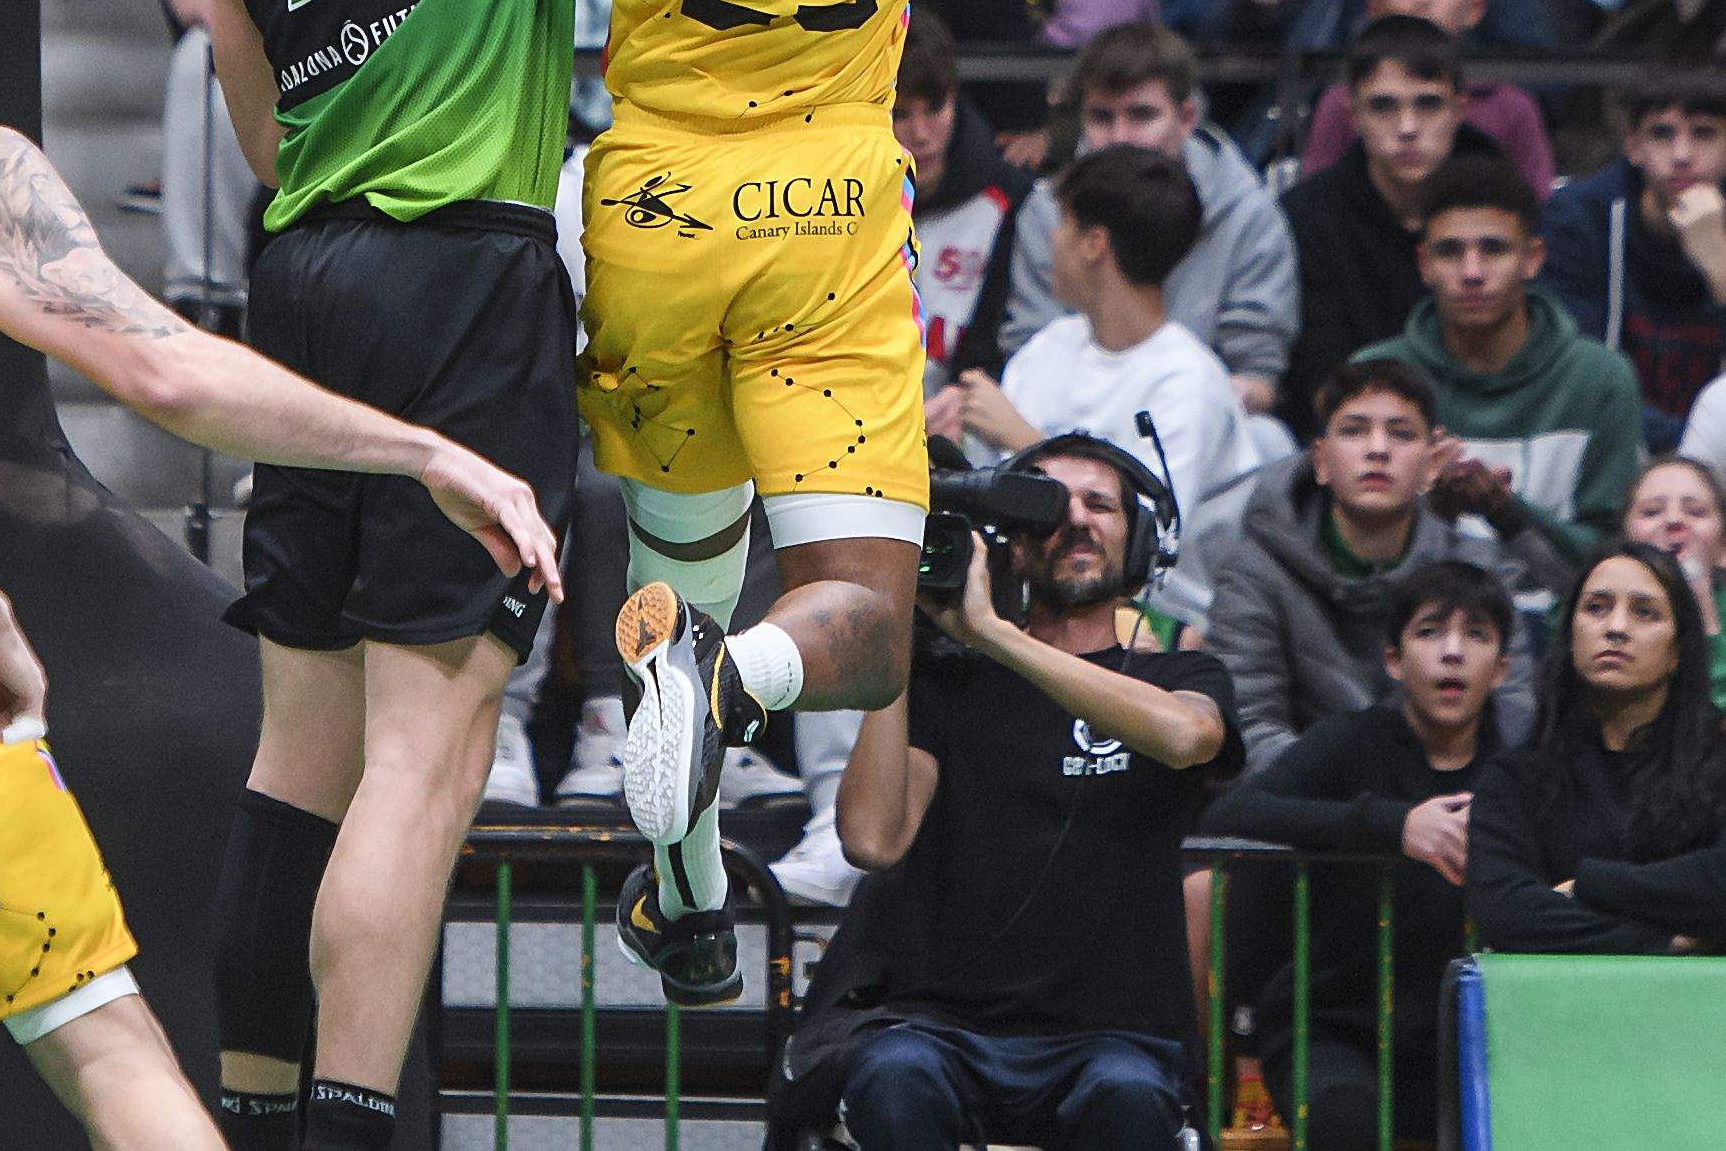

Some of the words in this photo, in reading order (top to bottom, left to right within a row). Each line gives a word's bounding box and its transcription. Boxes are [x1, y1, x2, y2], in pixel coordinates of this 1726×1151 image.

[280, 45, 343, 92] DALONA
[732, 177, 866, 222] CICAR
[735, 225, 790, 241] Canary
[795, 220, 842, 237] Islands
